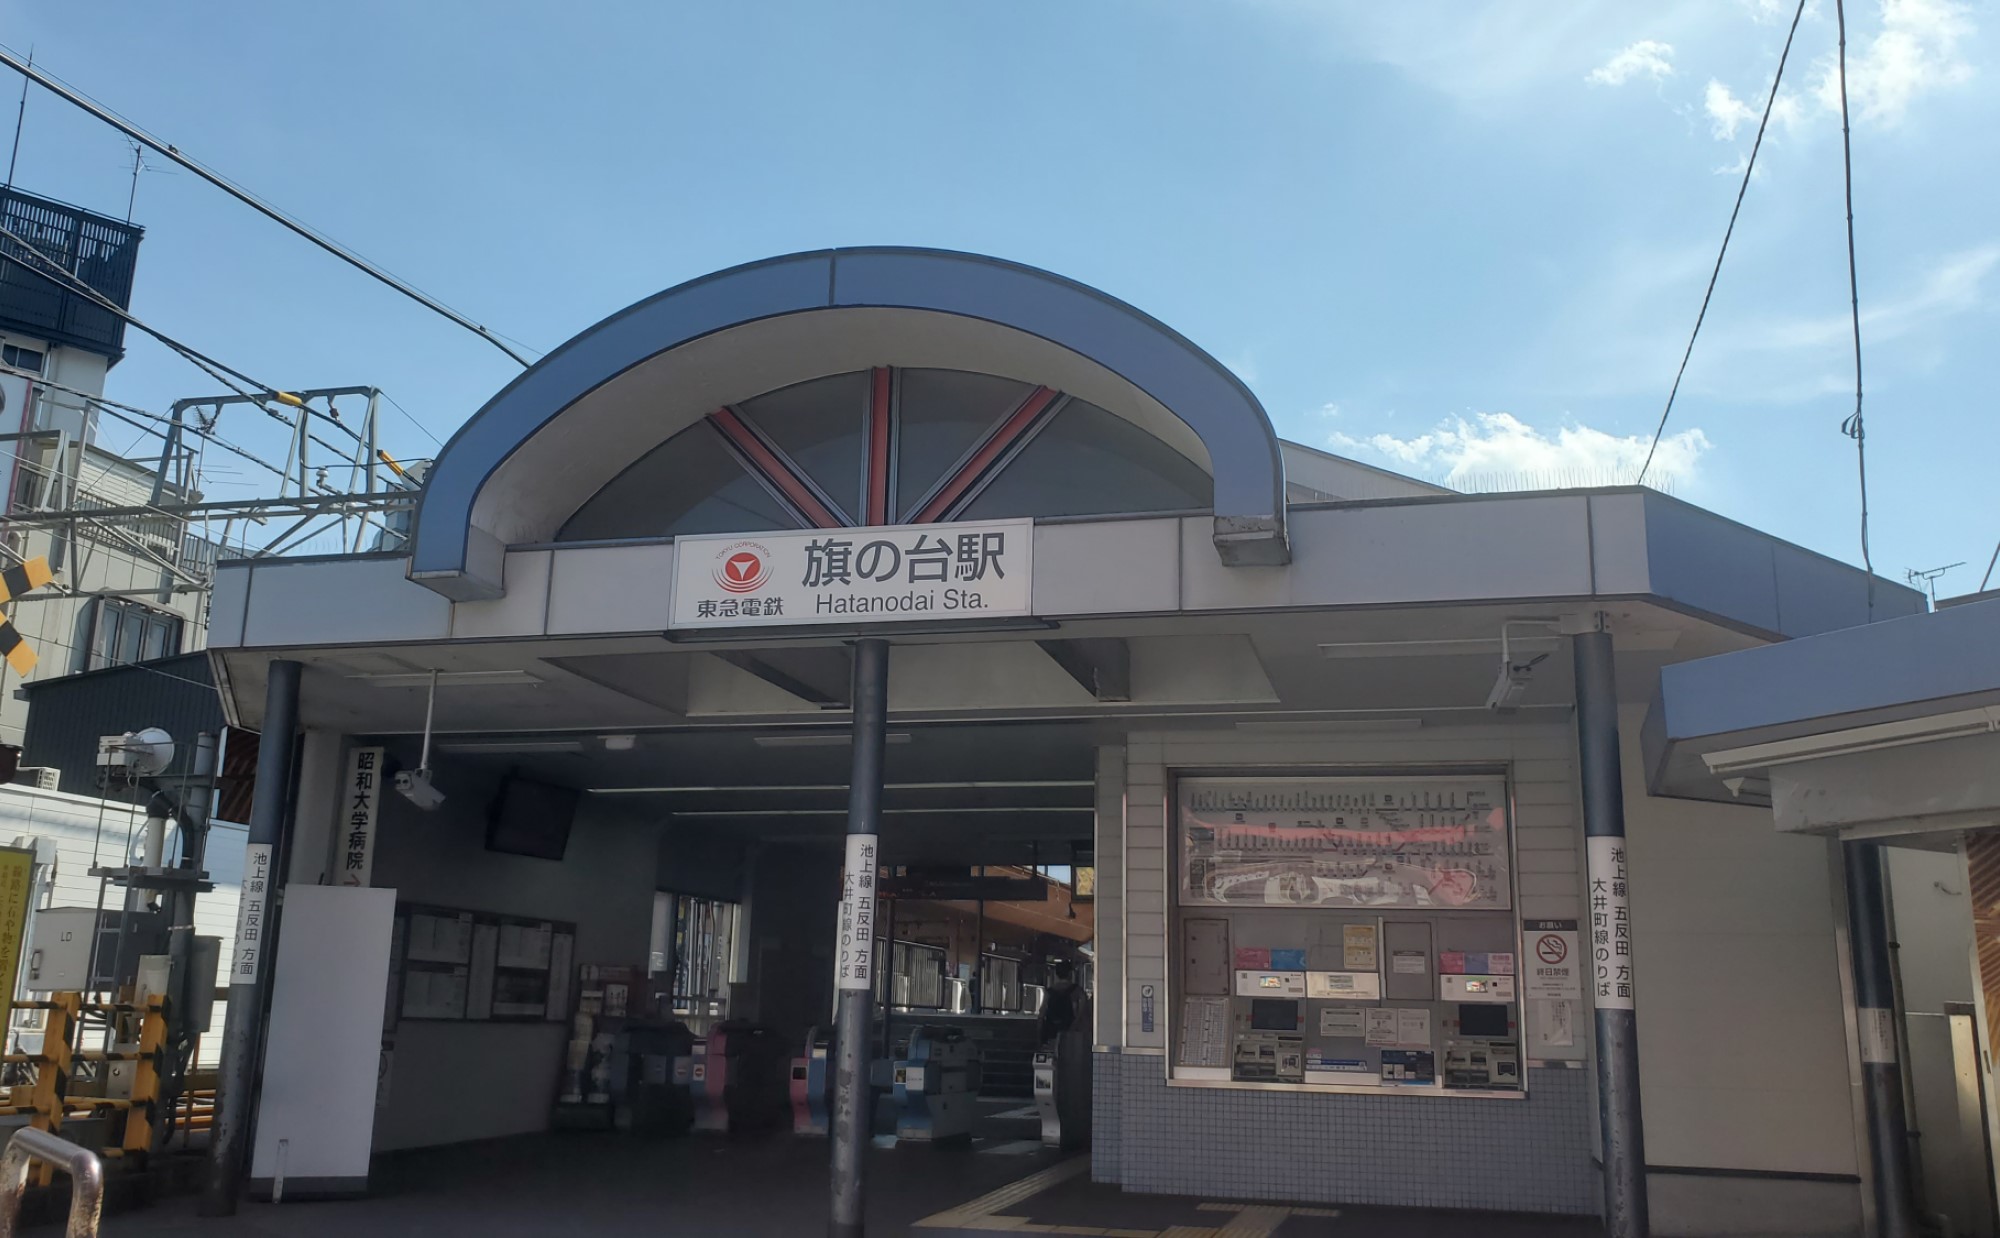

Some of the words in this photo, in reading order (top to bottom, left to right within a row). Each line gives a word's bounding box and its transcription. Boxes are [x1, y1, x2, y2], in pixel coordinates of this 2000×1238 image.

[715, 545, 733, 560] TOKYU
[734, 541, 771, 559] CORPORATION
[802, 532, 1005, 588] 旗の台駅
[697, 597, 784, 618] 東急電鉄
[816, 589, 934, 614] Hatanodai
[943, 588, 988, 610] Sta.
[346, 752, 375, 870] 昭和大学病院
[250, 852, 268, 893] 池上線
[858, 843, 874, 889] 池上線
[1611, 847, 1627, 898] 池上線
[244, 900, 262, 941] 五反田
[841, 872, 855, 978] 大井町線のりば
[856, 896, 871, 942] 五反田
[1592, 877, 1610, 997] 大井町線のりば
[1614, 906, 1629, 956] 五反田
[240, 948, 256, 975] 方面
[854, 948, 869, 979] 方面
[1616, 964, 1631, 998] 方面
